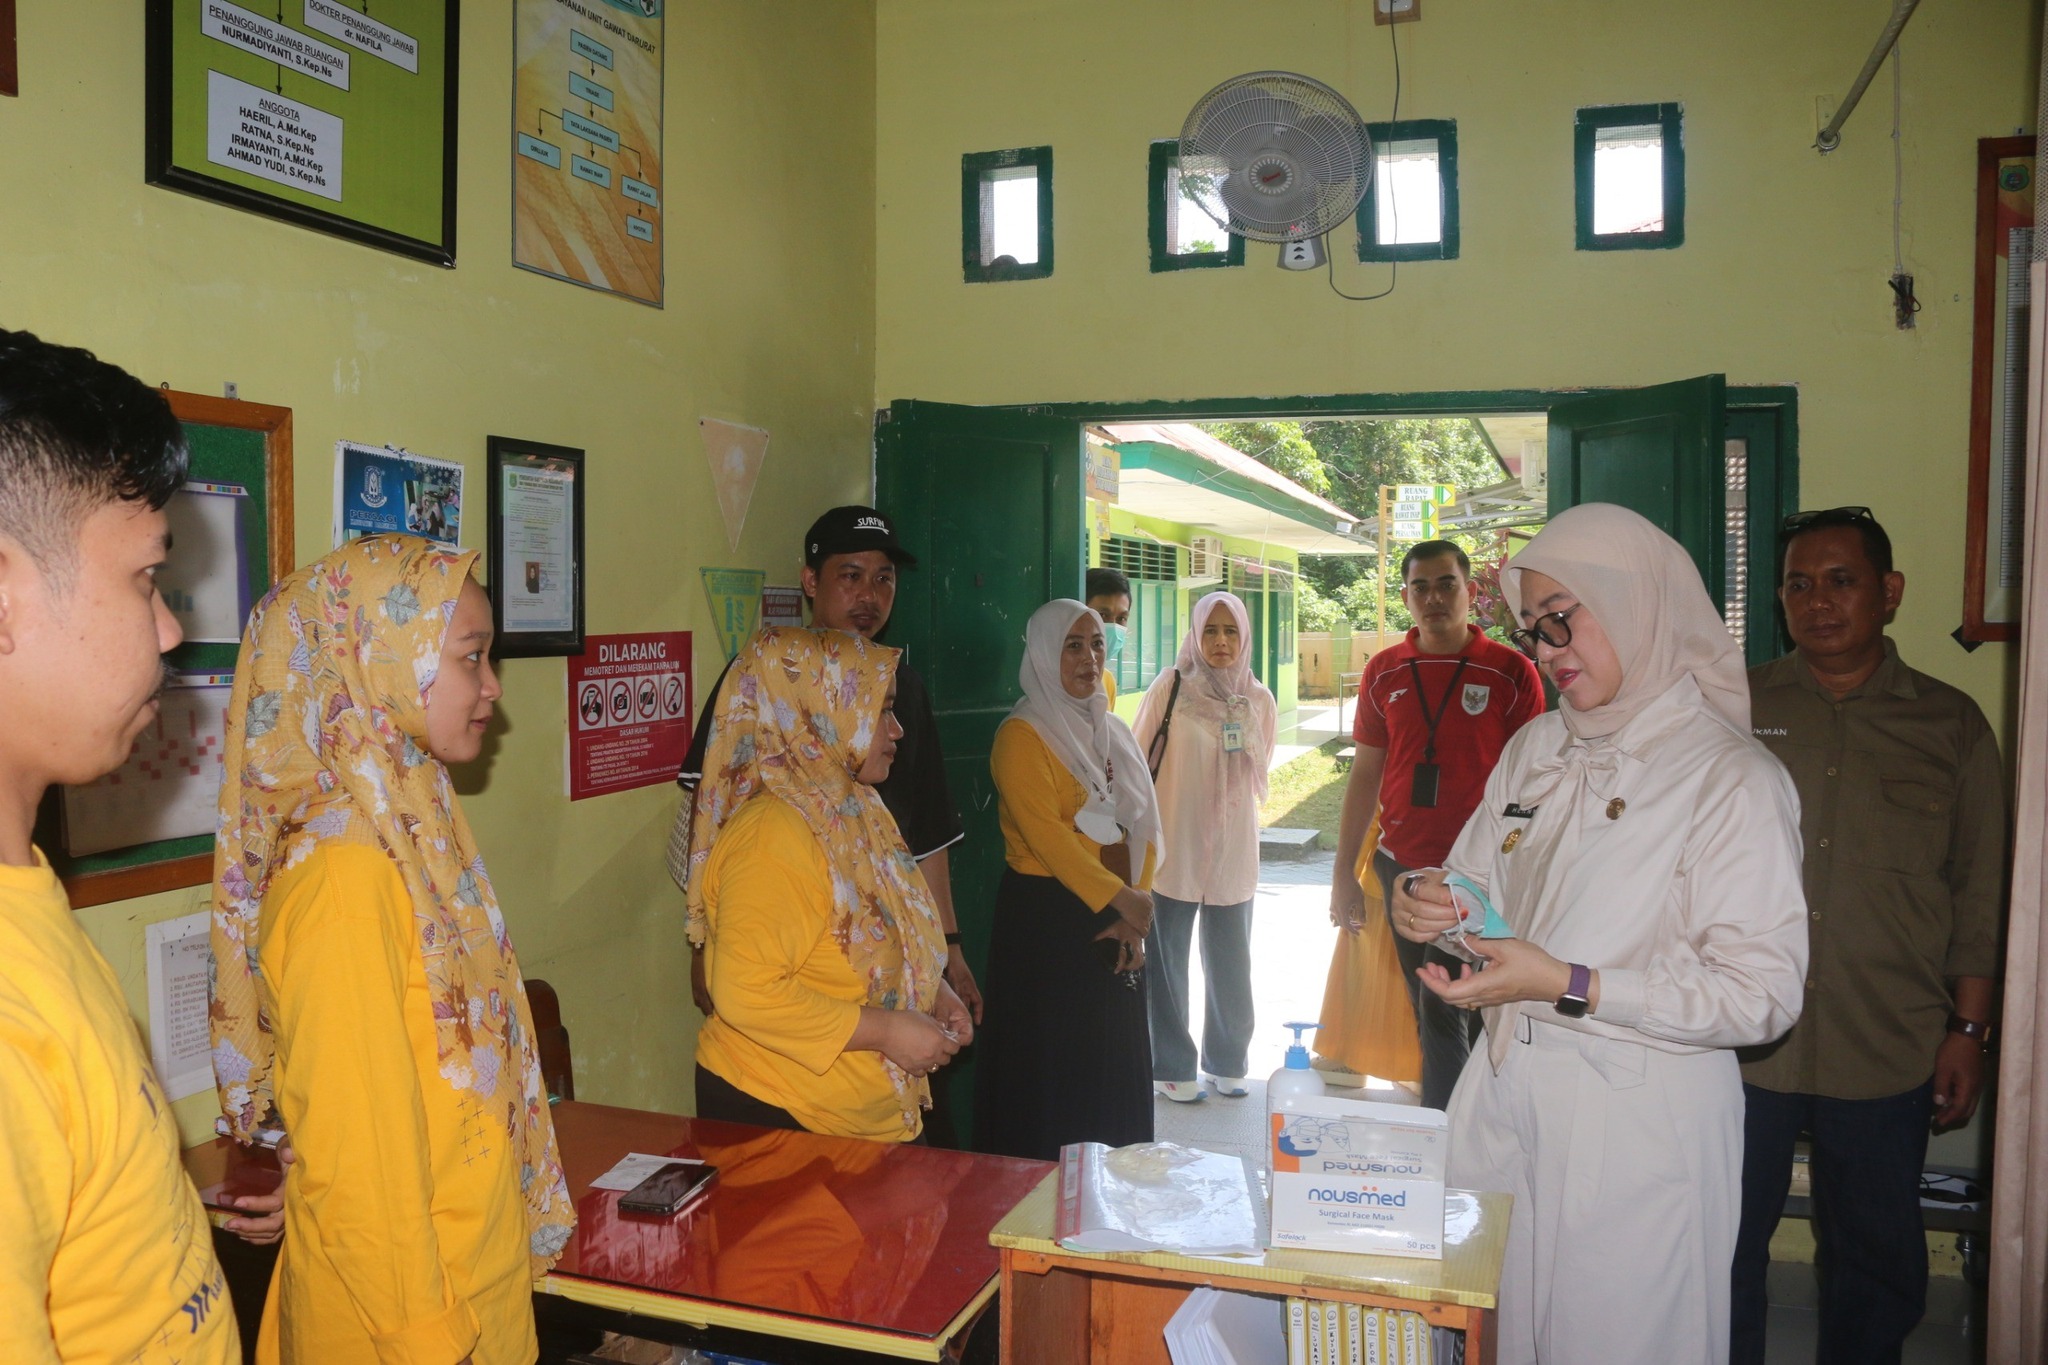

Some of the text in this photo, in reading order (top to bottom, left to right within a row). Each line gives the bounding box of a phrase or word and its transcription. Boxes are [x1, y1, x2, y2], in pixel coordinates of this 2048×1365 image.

[209, 4, 344, 69] PENANGGUNG JAWAB RUANGAN
[309, 0, 415, 55] DOKTER PENANGGUNG JAWAB
[587, 9, 602, 25] UNIT
[603, 20, 626, 39] GAWAT
[626, 32, 656, 55] DARURAT
[221, 25, 333, 78] NURMADIYANTI, S.Kep.Ns
[344, 28, 383, 52] dr. NAFILA
[259, 98, 300, 121] ANGGOTA
[239, 106, 317, 142] HAERIL, A.Md.Kep
[241, 122, 315, 155] RATNA, S.Kep.Ns
[231, 133, 323, 173] IRMAYANTI, A.Md.Kep
[227, 147, 326, 187] AHMAD YUDI, S.Kep.Ns
[1404, 487, 1428, 495] RUANG
[349, 509, 398, 523] PERSAGI
[599, 641, 666, 663] DILARANG
[583, 665, 615, 676] MEMOTRET
[615, 664, 627, 674] DAN
[627, 663, 653, 673] MEREKAM
[1323, 1160, 1422, 1175] nousmed
[1308, 1185, 1406, 1207] nousmed
[1318, 1209, 1395, 1222] Surgical Face Mask
[1276, 1232, 1306, 1241] Safelock
[1406, 1240, 1418, 1249] 50
[1419, 1242, 1436, 1251] pcs
